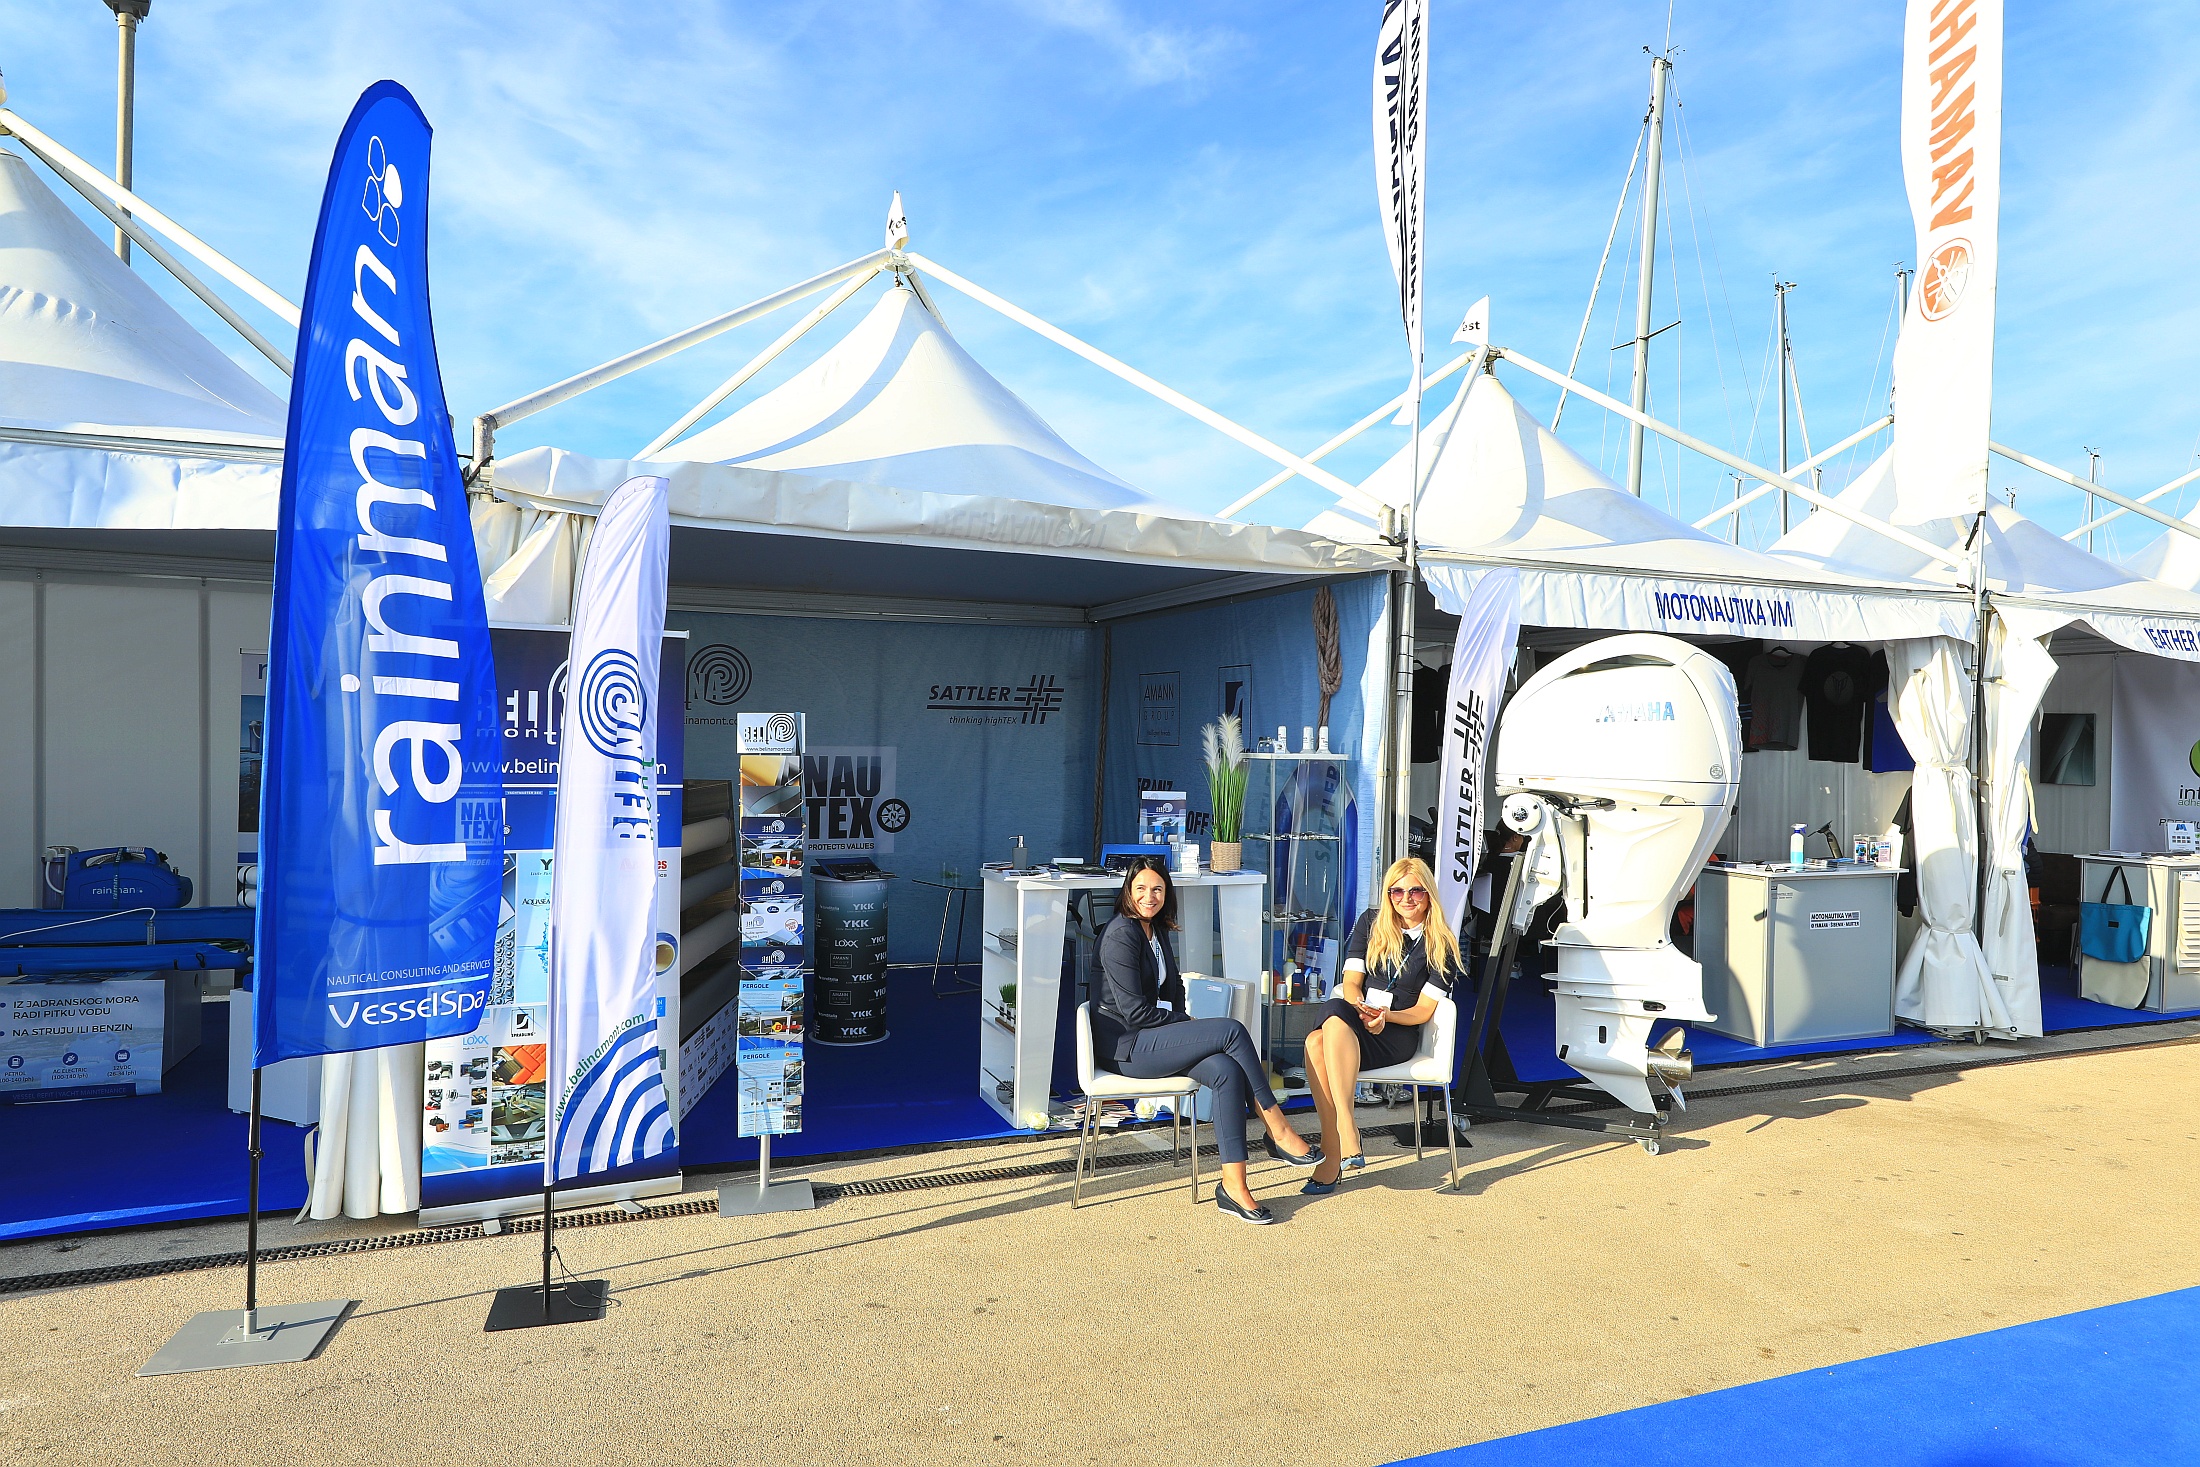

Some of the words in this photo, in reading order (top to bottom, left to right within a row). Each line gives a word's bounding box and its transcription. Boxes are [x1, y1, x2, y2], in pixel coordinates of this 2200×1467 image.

[341, 244, 467, 866] rainman
[1655, 592, 1766, 626] MOTONAUTIKA
[1767, 600, 1793, 627] VM
[928, 685, 1011, 701] SATTLER
[1144, 683, 1174, 701] AMANN
[1143, 710, 1175, 720] GROUP
[949, 716, 982, 726] thinking
[984, 717, 1017, 727] highTEX
[803, 755, 882, 798] NAU
[805, 797, 875, 840] TEX
[1453, 767, 1474, 885] SATTLER
[846, 842, 875, 850] VALUES
[852, 902, 875, 911] YKK
[843, 919, 869, 928] YKK
[834, 938, 859, 949] LOXX
[327, 975, 378, 986] NAUTICAL
[380, 965, 441, 980] CONSULTING
[441, 961, 460, 974] AND
[461, 959, 491, 971] SERVICES
[851, 973, 873, 982] YKK
[13, 1001, 24, 1009] IZ
[26, 997, 103, 1008] JADRANSKOG
[105, 996, 140, 1004] MORA
[13, 1011, 41, 1019] RADI
[43, 1009, 76, 1018] PITKU
[78, 1008, 111, 1016] VODU
[851, 1009, 873, 1018] YKK
[12, 1029, 30, 1037] NA
[31, 1026, 74, 1036] STRUJU
[77, 1025, 89, 1034] ILI
[91, 1023, 133, 1033] BENZIN
[840, 1026, 867, 1036] YKK
[462, 1034, 489, 1046] LOXX
[555, 1013, 645, 1122] www.belinamont.com
